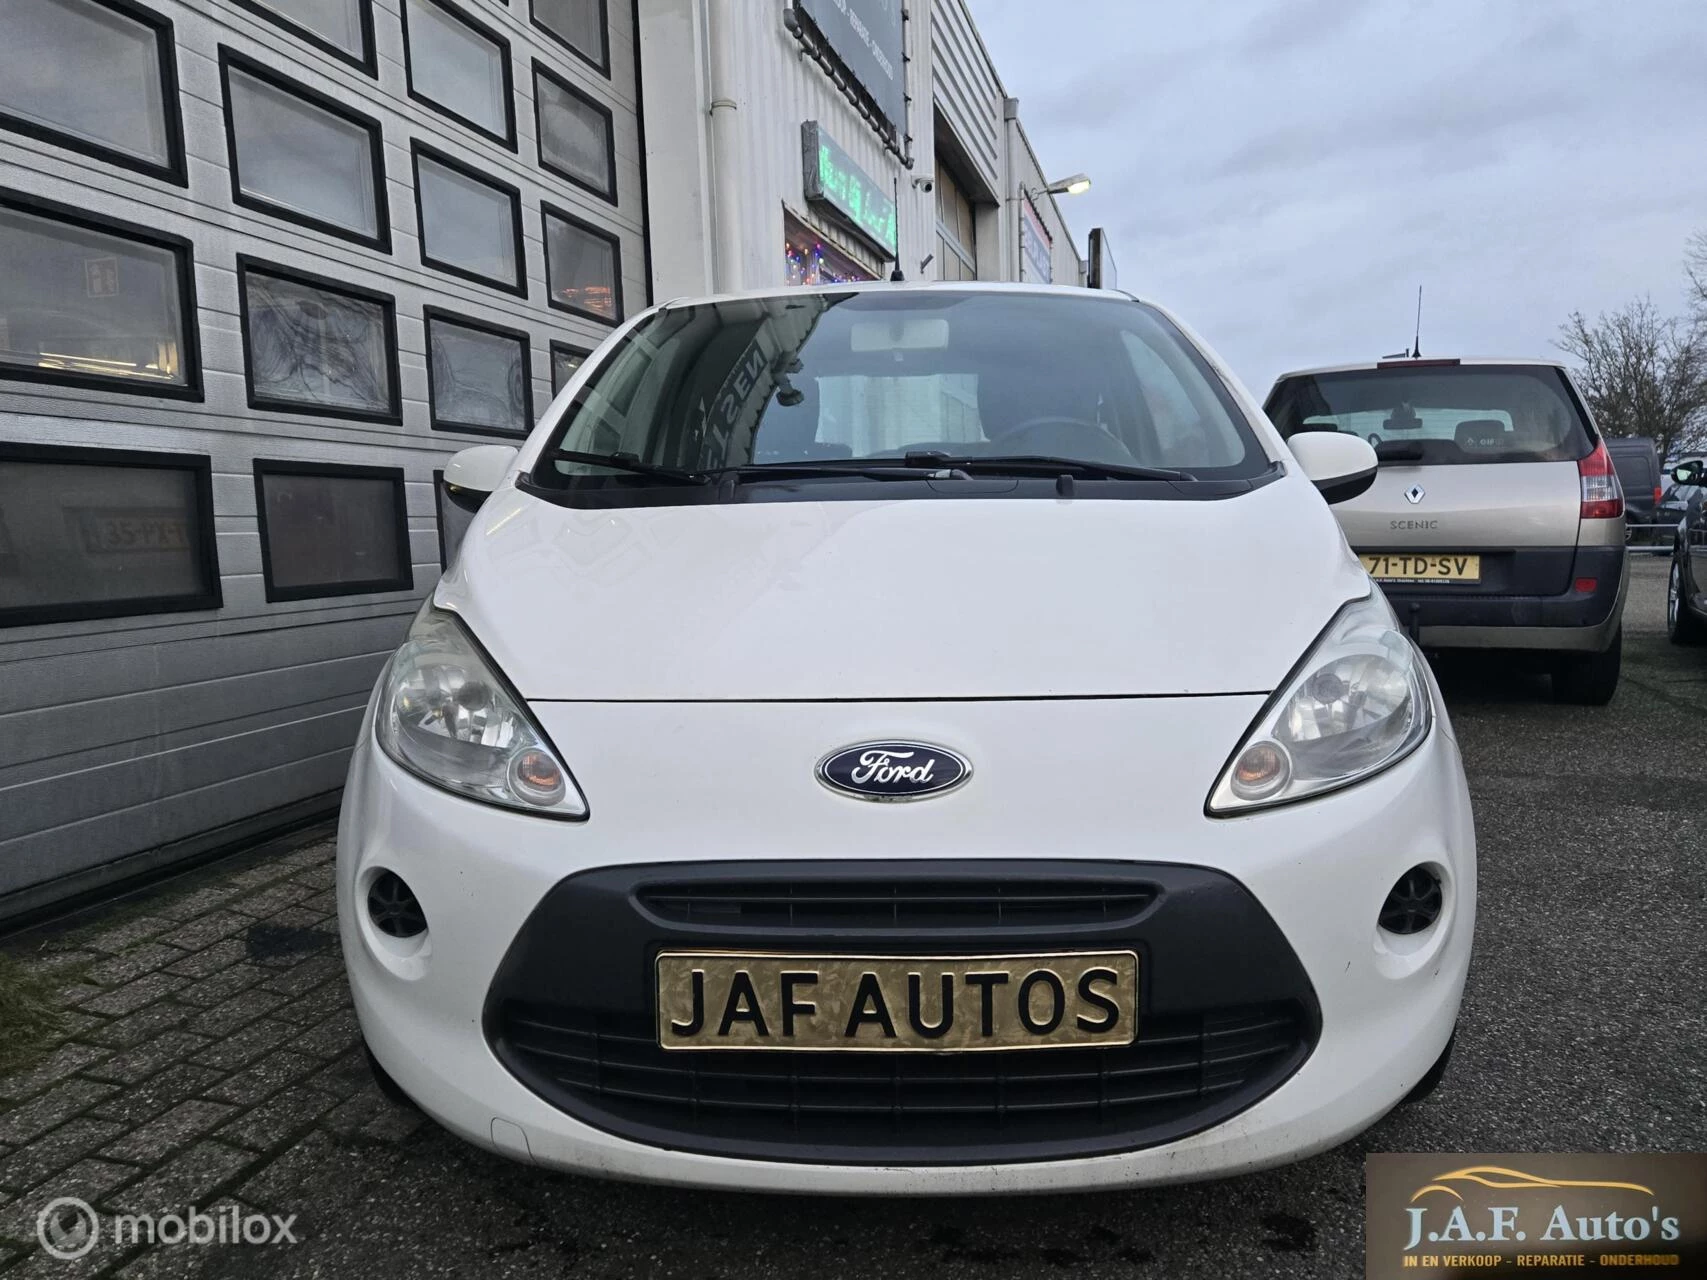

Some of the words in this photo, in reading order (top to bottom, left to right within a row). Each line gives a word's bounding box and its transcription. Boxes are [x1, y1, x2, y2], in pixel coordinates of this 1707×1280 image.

[1390, 519, 1439, 530] SCENIC
[1368, 556, 1469, 576] 71-TD-SV
[851, 750, 936, 784] Ford
[671, 968, 820, 1037] JAF
[844, 967, 1121, 1038] AUTOS
